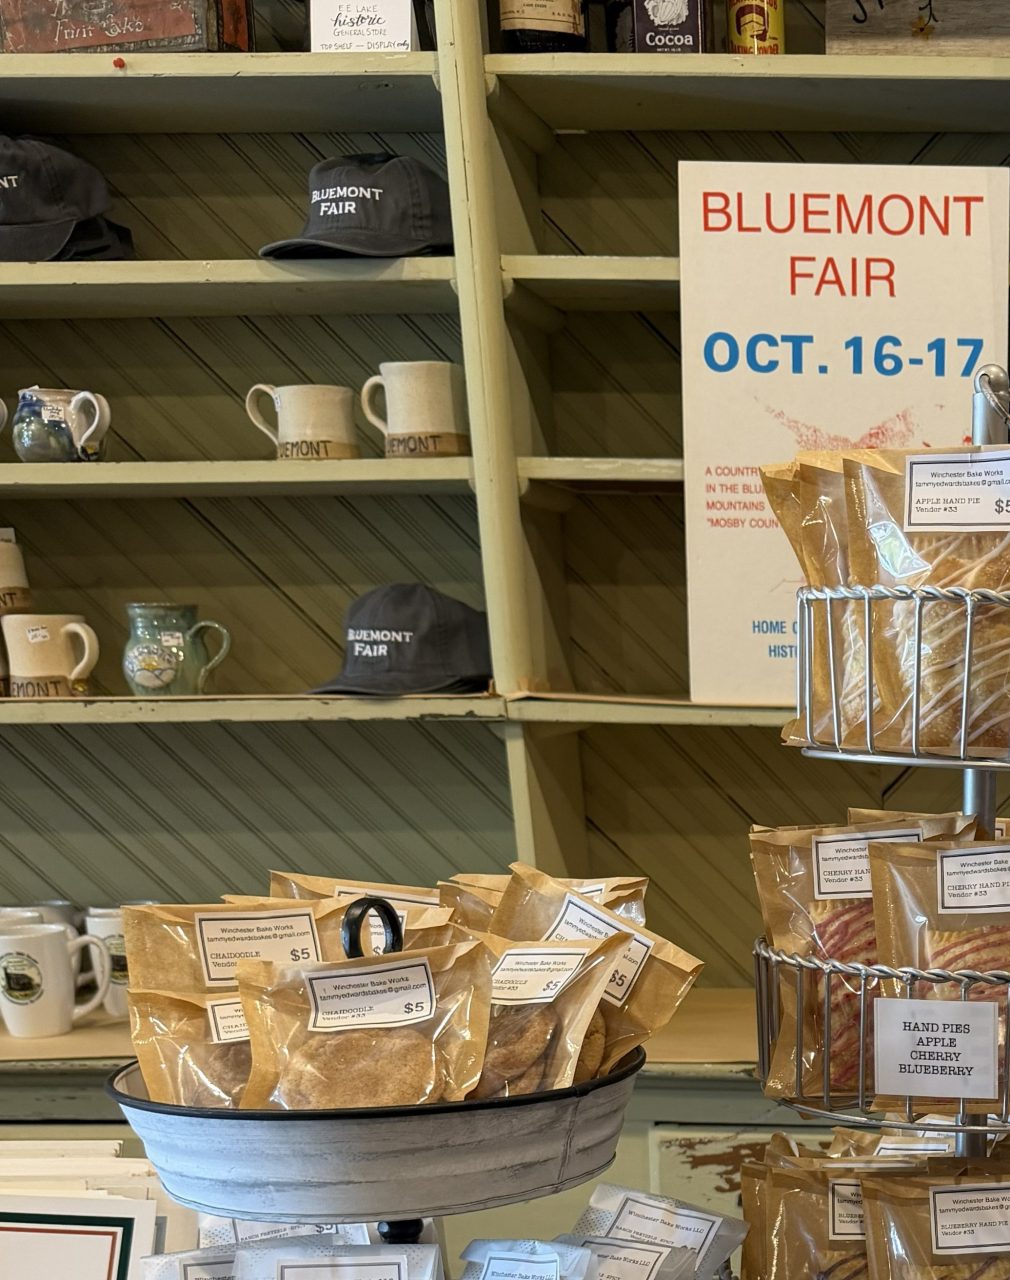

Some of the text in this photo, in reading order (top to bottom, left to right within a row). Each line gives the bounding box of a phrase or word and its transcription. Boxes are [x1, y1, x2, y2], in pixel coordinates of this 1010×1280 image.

[331, 13, 386, 27] historic
[333, 28, 388, 37] GENERAL STORE
[645, 32, 694, 46] Cocoa
[367, 41, 396, 50] DISPLAY
[311, 186, 383, 204] BLUEMONT
[319, 201, 357, 216] FAIR
[702, 191, 984, 237] BLUEMONT
[789, 256, 897, 298] FAIR
[703, 331, 985, 378] OCT. 16-17
[705, 466, 761, 477] A COUNTR
[705, 483, 766, 494] IN THE BLU
[706, 501, 766, 512] MOUNTAINS
[707, 518, 780, 529] "MOSBY COUN
[752, 620, 786, 634] HOME
[353, 642, 388, 657] FAIR
[768, 645, 797, 658] HIST
[290, 947, 311, 961] $5
[542, 980, 562, 992] $5
[403, 1001, 425, 1014] $5
[902, 1021, 971, 1034] HAND PIES
[916, 1036, 957, 1048] APPLE
[909, 1050, 962, 1062] CHERRY
[898, 1063, 975, 1076] BLUEBERRY
